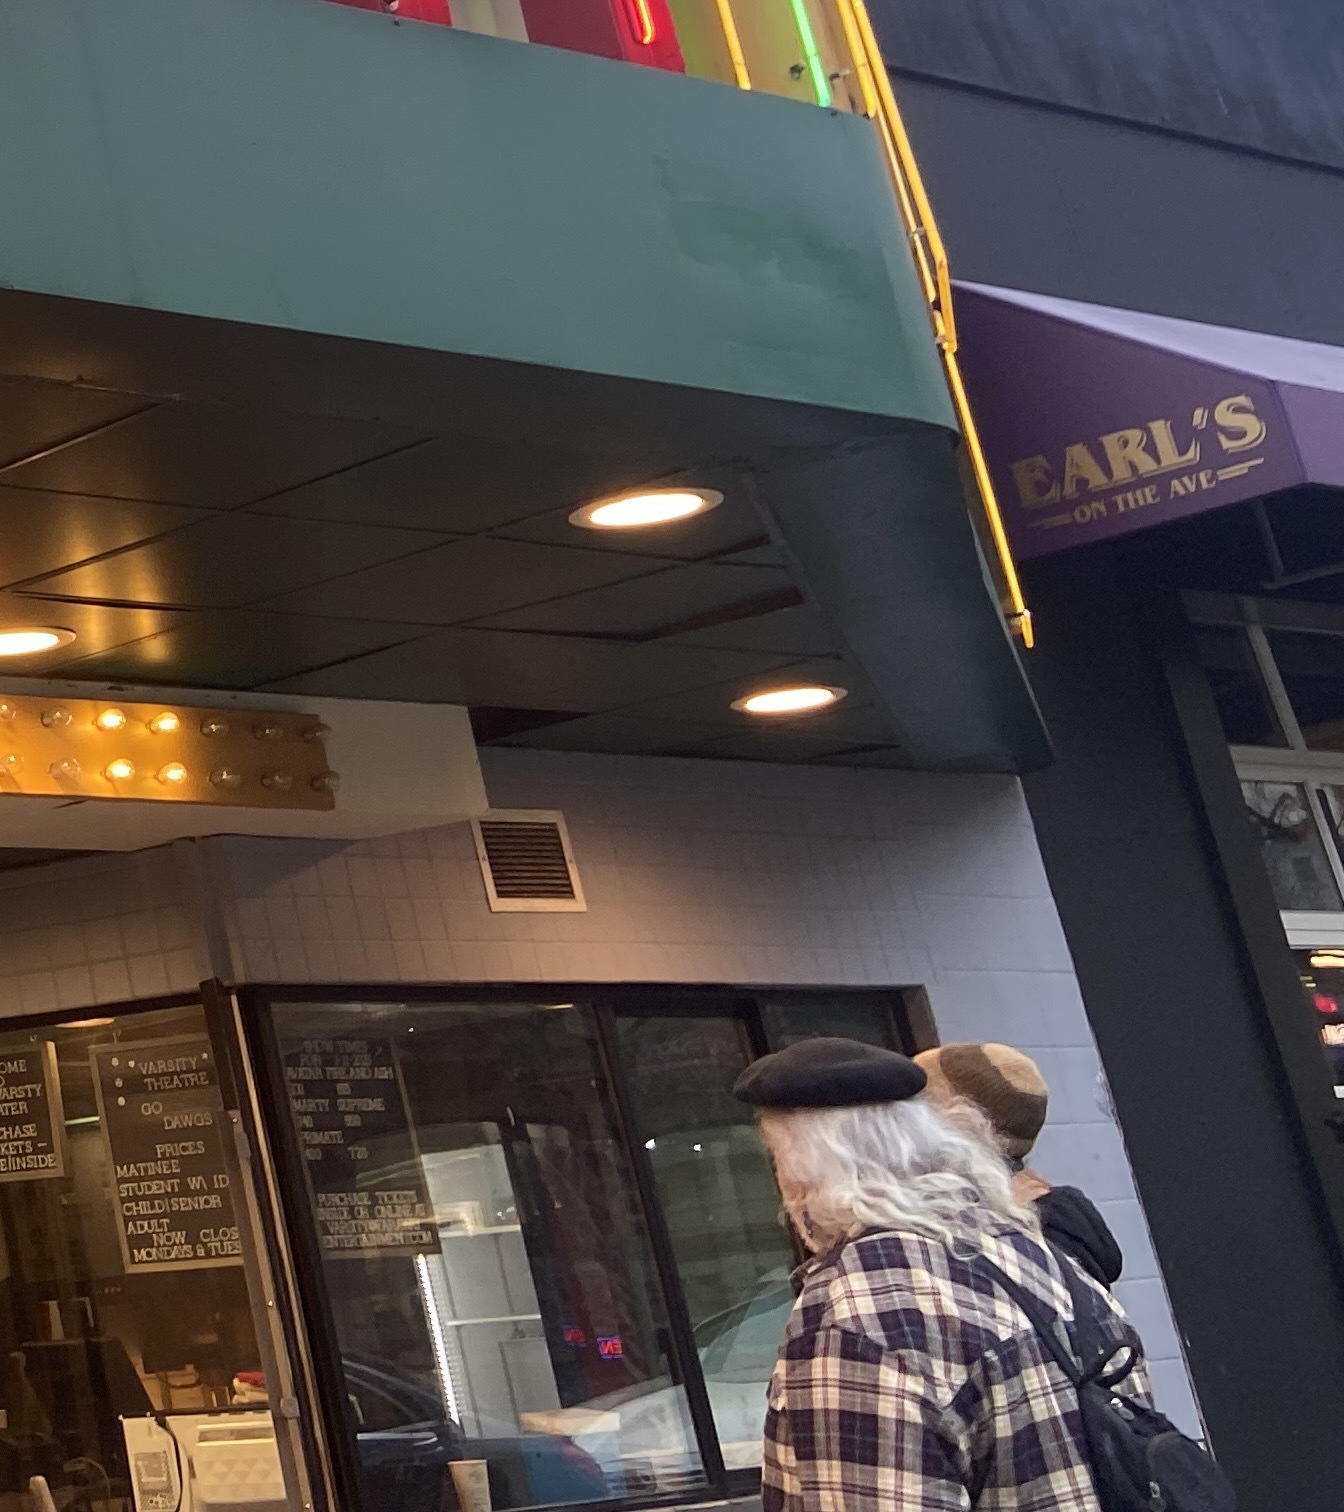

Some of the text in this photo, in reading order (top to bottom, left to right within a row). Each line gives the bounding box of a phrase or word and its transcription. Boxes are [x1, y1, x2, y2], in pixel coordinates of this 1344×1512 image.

[1010, 393, 1266, 508] EARL'S
[1072, 469, 1216, 524] ON THE AVE
[138, 1055, 199, 1075] VARSITY
[143, 1071, 209, 1091] THEATRE
[141, 1101, 163, 1116] GO
[163, 1111, 213, 1130] DAWGS
[155, 1140, 206, 1158] PRICES
[116, 1159, 181, 1178] MATINEE
[119, 1178, 181, 1197] STUDENT
[213, 1174, 230, 1189] ID
[127, 1218, 171, 1235] ADULT
[152, 1226, 239, 1247] NOW CLOS
[133, 1244, 193, 1263] MONDAYS
